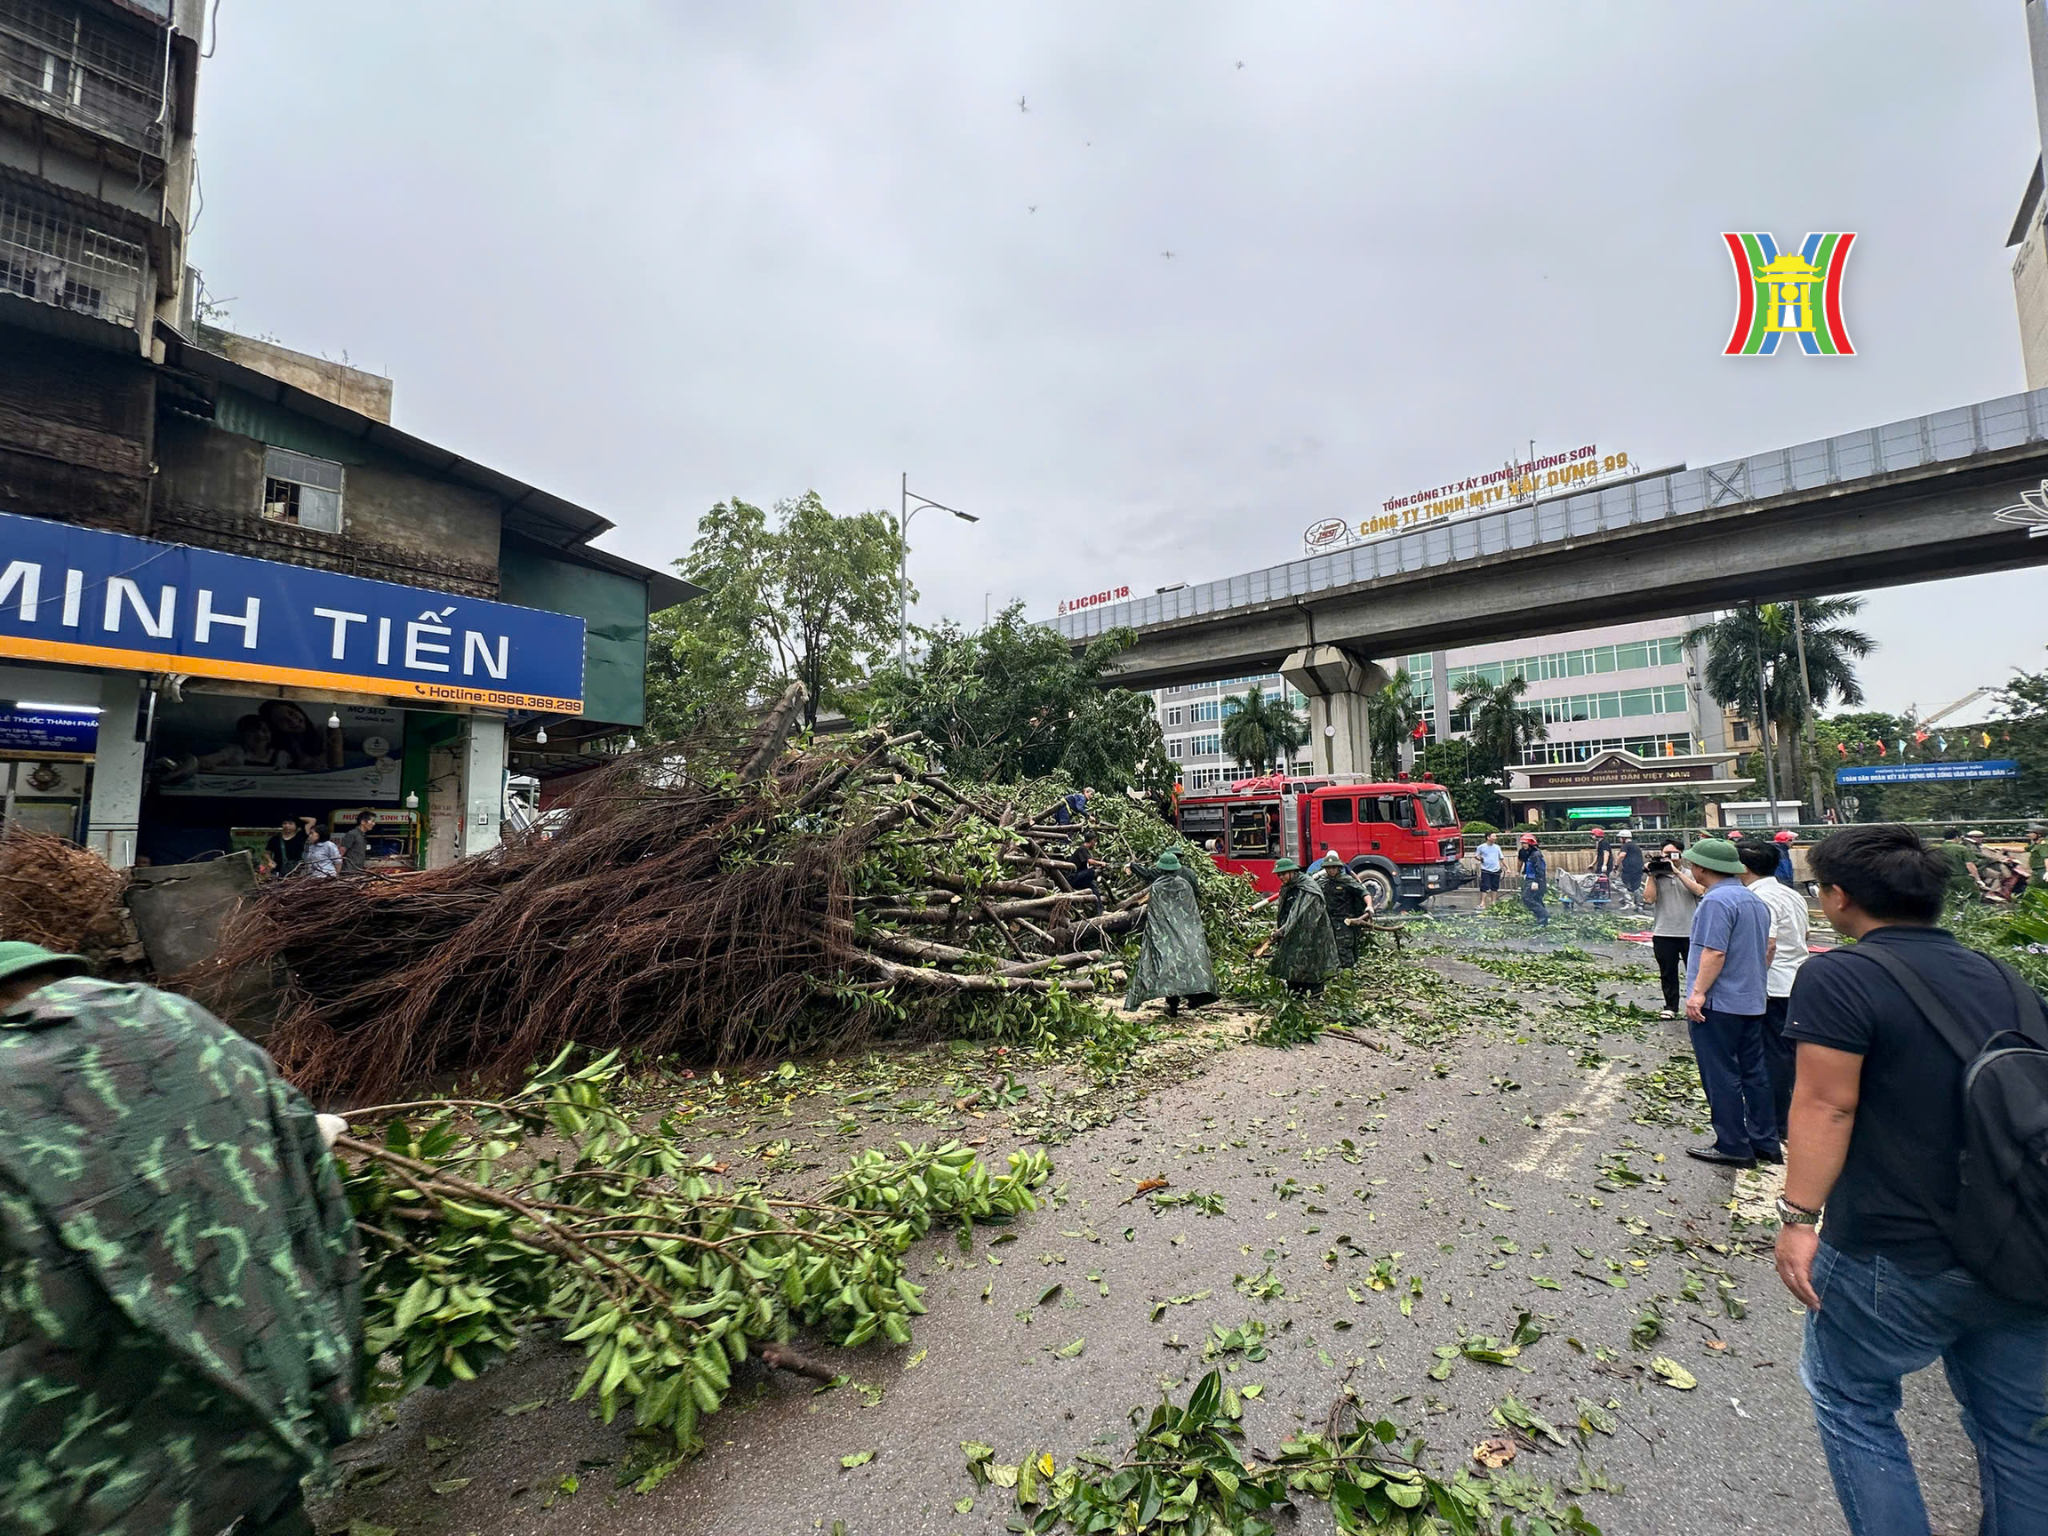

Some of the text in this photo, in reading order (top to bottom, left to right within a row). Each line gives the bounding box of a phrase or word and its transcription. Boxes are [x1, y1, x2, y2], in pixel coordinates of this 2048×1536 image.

[1360, 452, 1628, 535] CÔNG TY TNHH MTV XÂY DỰNG 99
[1382, 496, 1408, 511] TỔNG
[1410, 490, 1439, 504] CÔNG
[1441, 484, 1456, 496] TY
[1457, 477, 1478, 492] XÂY
[1569, 444, 1596, 461] SƠN
[1069, 586, 1129, 611] LICOGI 18
[314, 606, 509, 680] TIẾN
[429, 686, 582, 712] Hotline: 0966.369.299
[1667, 771, 1690, 779] NAM
